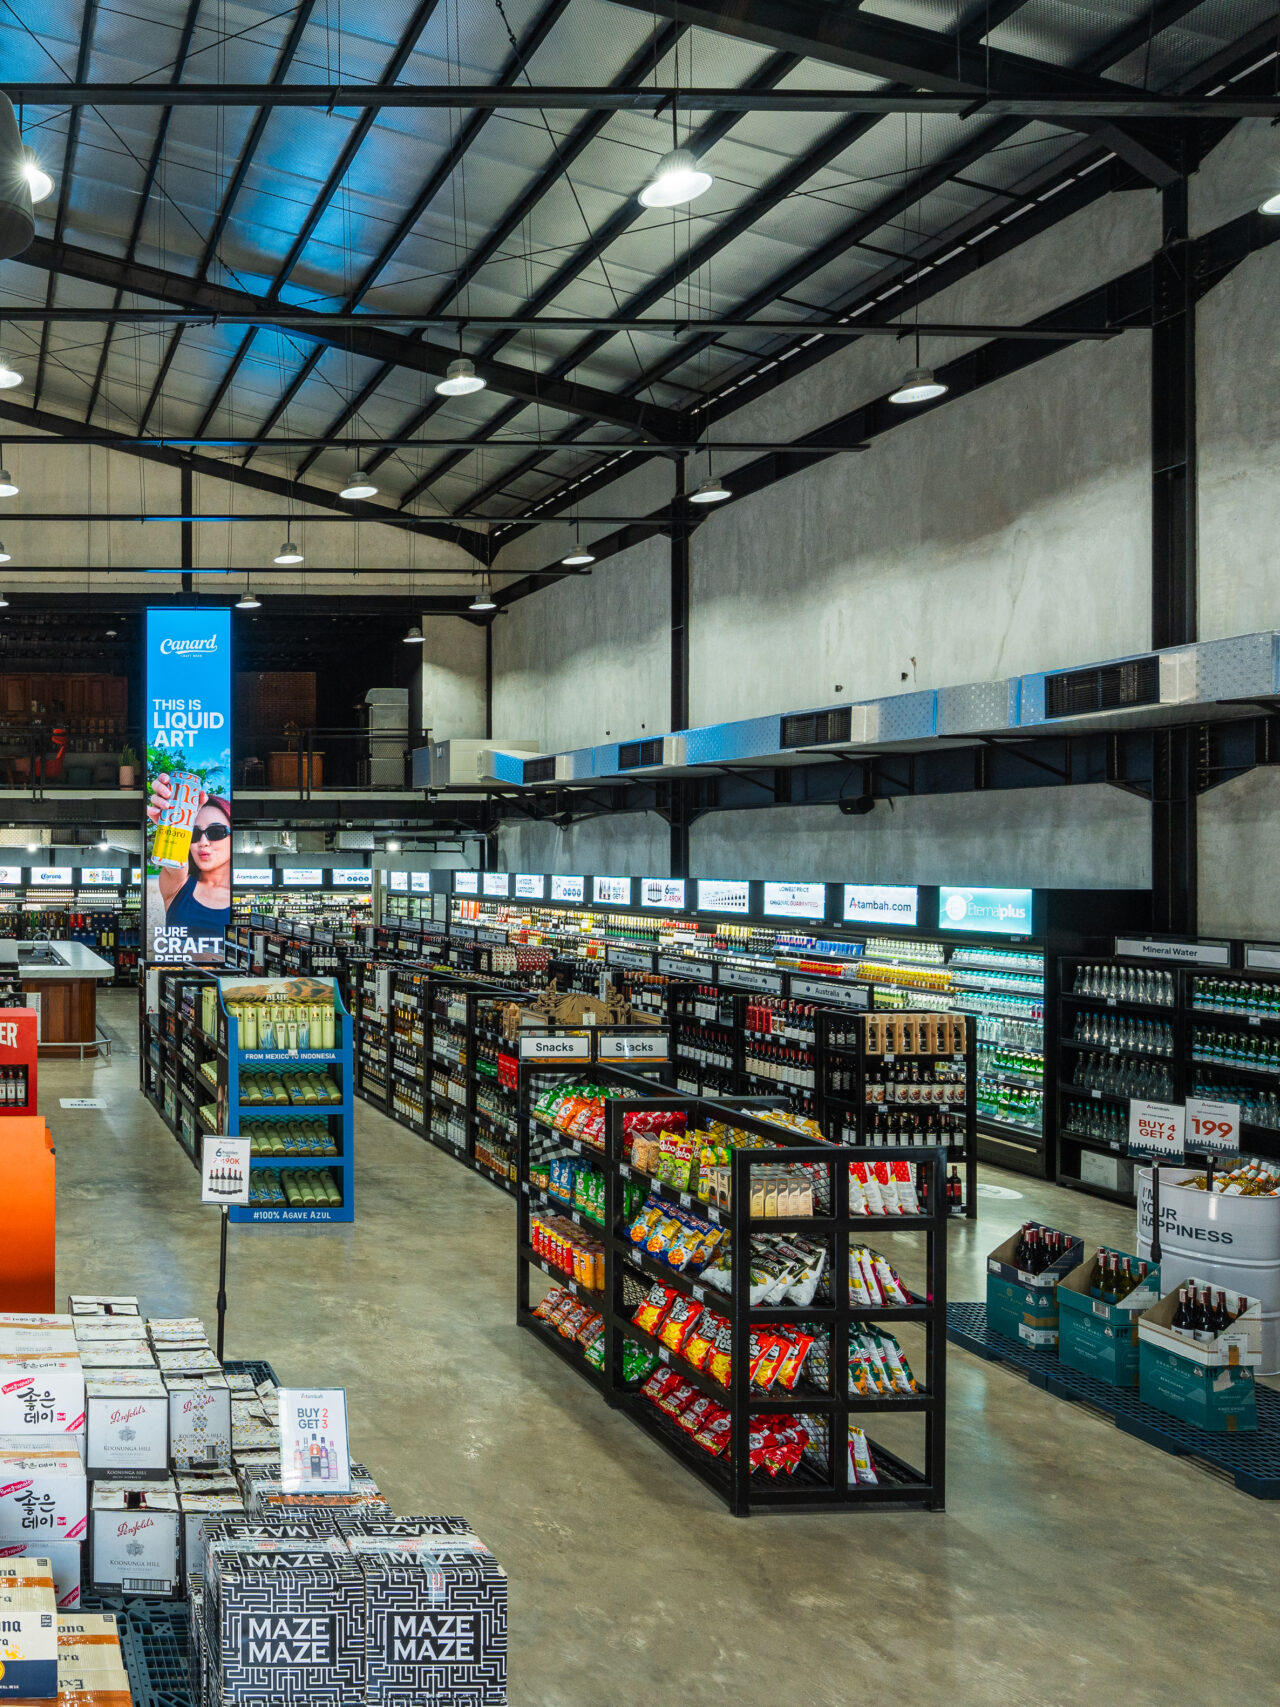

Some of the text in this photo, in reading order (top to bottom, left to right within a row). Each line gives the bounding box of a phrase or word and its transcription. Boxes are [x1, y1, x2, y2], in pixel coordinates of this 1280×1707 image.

[160, 634, 218, 655] Canard
[152, 699, 201, 711] THIS IS
[153, 712, 224, 730] LIQUID
[153, 730, 198, 747] ART
[664, 884, 670, 895] 6
[849, 897, 912, 912] Atambah.com
[154, 926, 188, 937] PURE
[153, 937, 224, 954] CRAFT
[1142, 945, 1198, 957] Mineral Water
[737, 974, 758, 983] Australia
[815, 987, 840, 997] Australia
[535, 1042, 574, 1052] Snacks
[615, 1041, 654, 1053] Snacks
[1138, 1118, 1176, 1133] BUY 4
[1191, 1118, 1233, 1138] 199
[1139, 1128, 1175, 1141] GET 6
[215, 1148, 222, 1157] 6
[253, 1211, 331, 1220] #100% AGAVE AZUL
[1141, 1200, 1177, 1221] YOUR
[1141, 1213, 1233, 1244] HAPPINESS
[17, 1387, 56, 1412] 좋은
[24, 1409, 54, 1425] 데이
[110, 1405, 146, 1424] Penfolds
[297, 1408, 329, 1418] BUY 2
[298, 1419, 329, 1429] GET 3
[14, 1490, 56, 1516] 좋은
[22, 1513, 54, 1530] 데이
[117, 1517, 155, 1537] Penfolds
[371, 1523, 446, 1535] MAZE
[231, 1524, 310, 1537] MAZE
[248, 1553, 326, 1568] MAZE
[389, 1551, 469, 1566] MAZE
[248, 1617, 330, 1640] MAZE
[394, 1615, 475, 1638] MAZE
[248, 1641, 330, 1664] MAZE
[394, 1639, 475, 1661] MAZE
